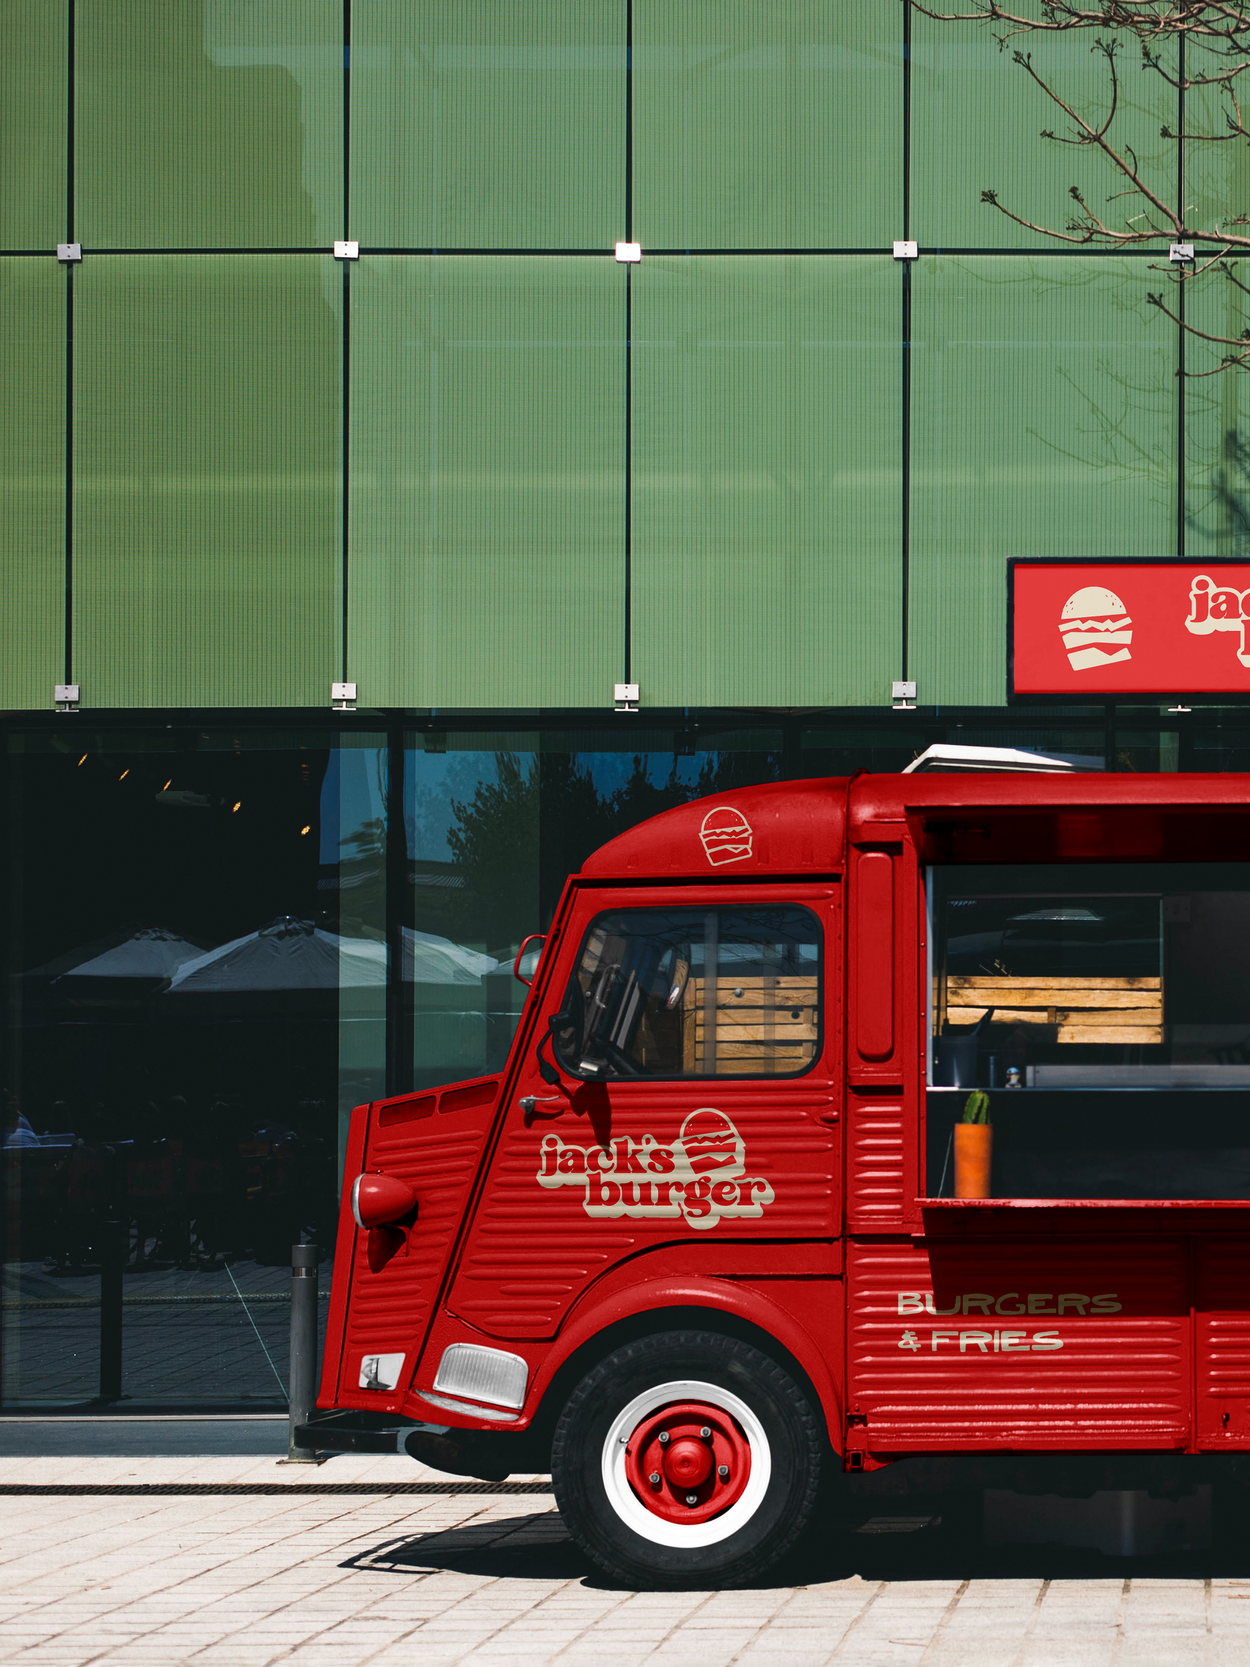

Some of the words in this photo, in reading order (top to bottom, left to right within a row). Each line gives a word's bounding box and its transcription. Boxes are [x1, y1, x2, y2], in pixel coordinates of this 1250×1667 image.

[539, 1135, 677, 1178] jack's
[585, 1172, 769, 1220] burger
[898, 1293, 1122, 1315] BURGERS
[898, 1330, 921, 1352] &
[932, 1330, 1064, 1352] FRIES
